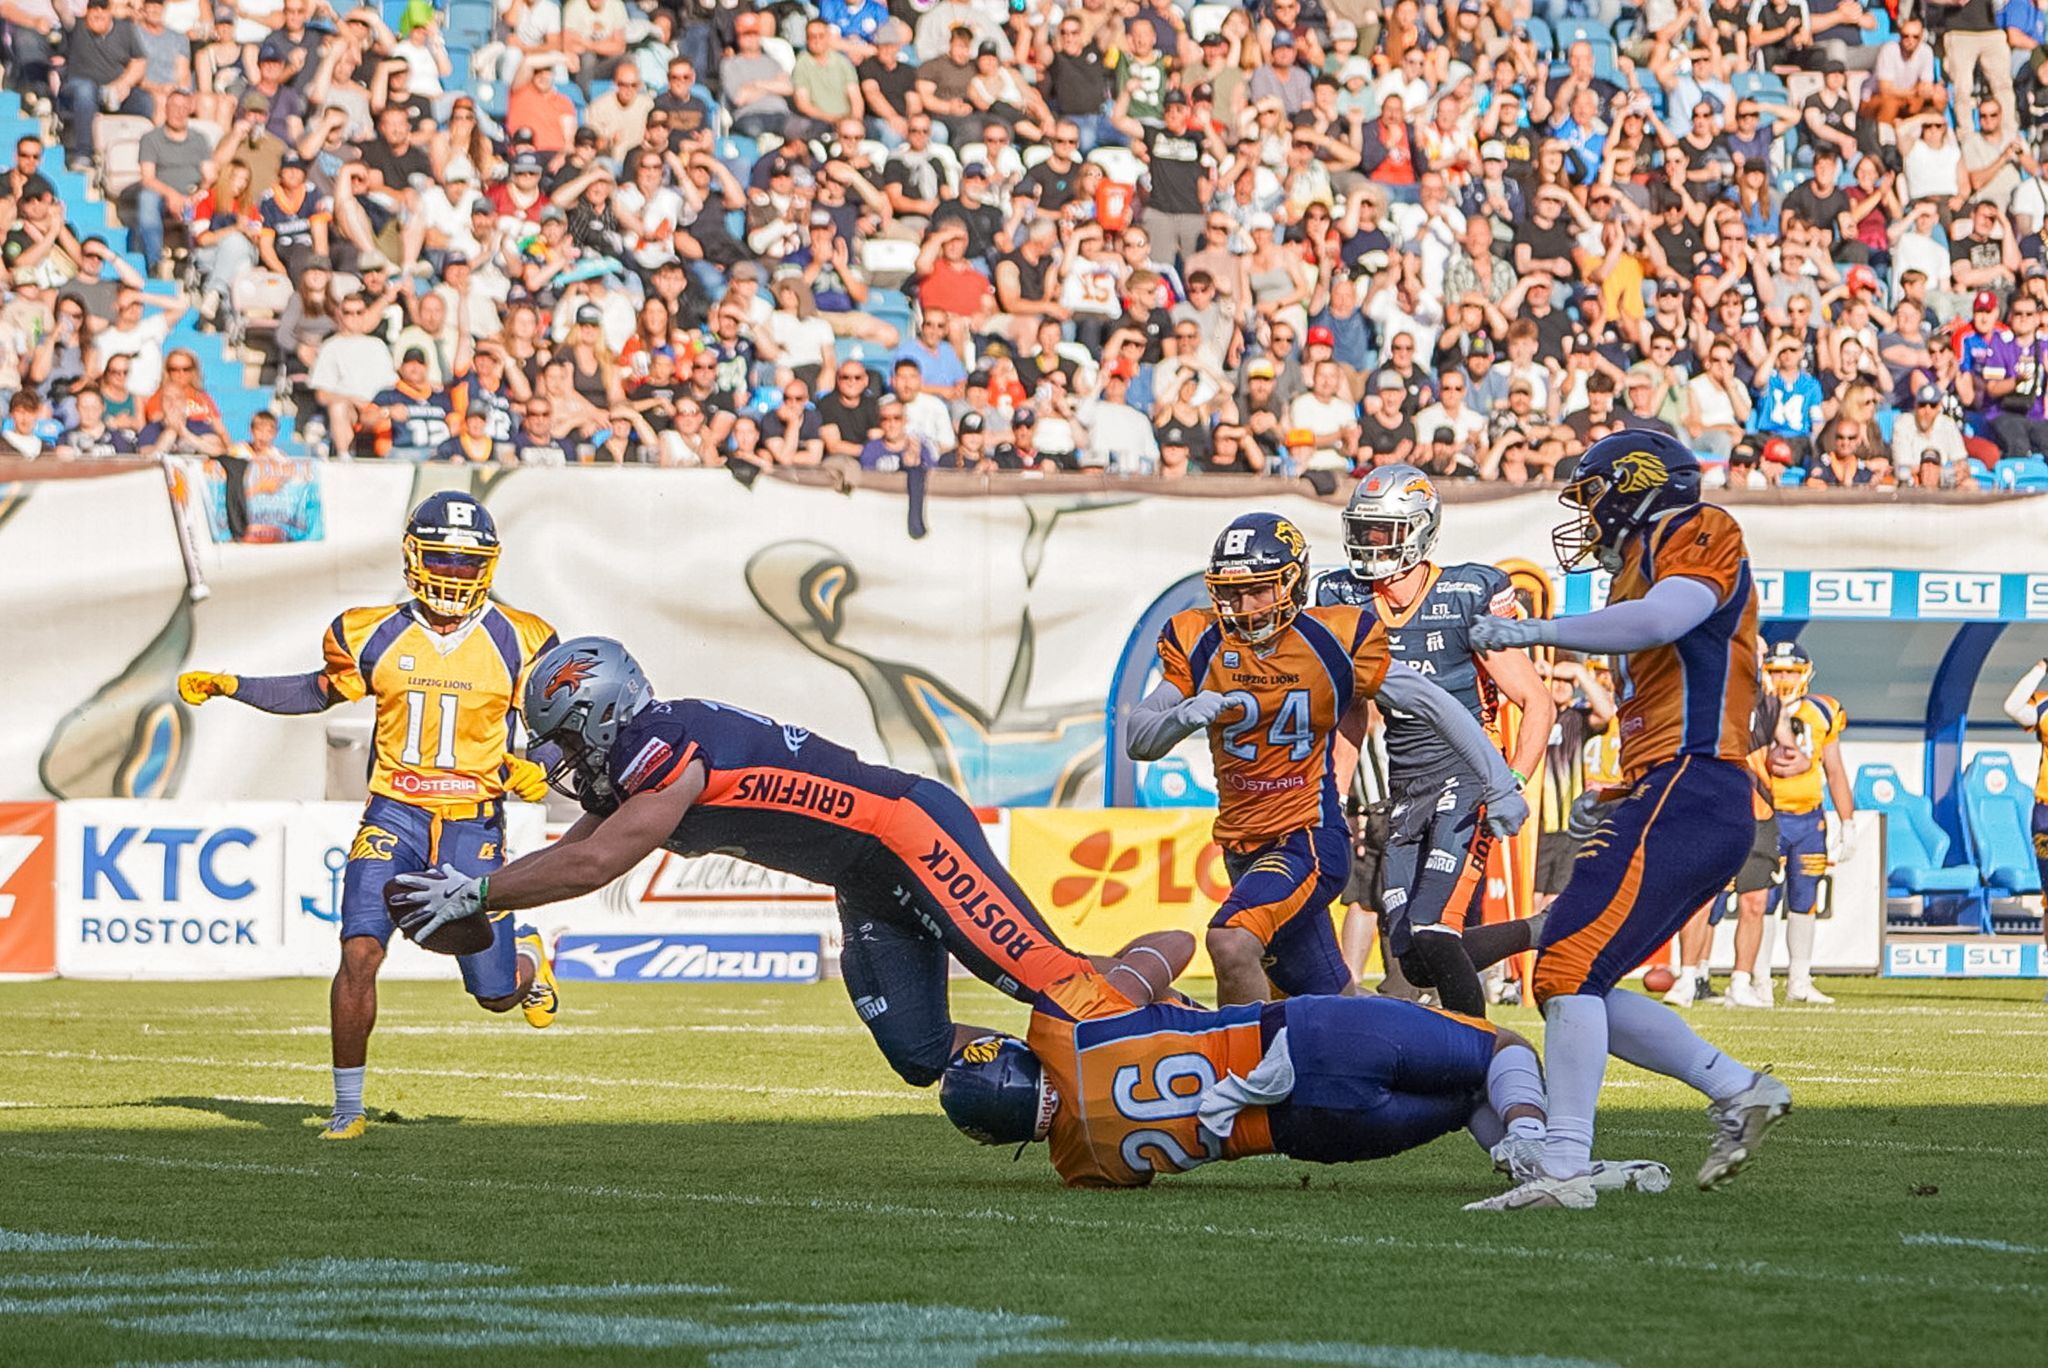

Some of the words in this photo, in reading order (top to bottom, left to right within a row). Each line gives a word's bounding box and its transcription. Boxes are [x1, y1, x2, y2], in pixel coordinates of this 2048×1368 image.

[1816, 579, 1886, 602] SLT
[1925, 581, 1995, 604] SLT
[408, 676, 442, 688] LEIPZIG
[444, 680, 473, 690] LIONS
[1232, 673, 1268, 685] LEIPZIG
[1270, 673, 1300, 685] LIONS
[401, 689, 459, 769] 11
[1221, 688, 1315, 762] 24
[733, 772, 856, 819] GRIFFINS
[82, 826, 258, 901] KTC
[919, 838, 1036, 962] ROSTOCK
[82, 918, 257, 945] ROSTOCK
[1895, 949, 1942, 965] SLT
[1969, 949, 2016, 965] SLT
